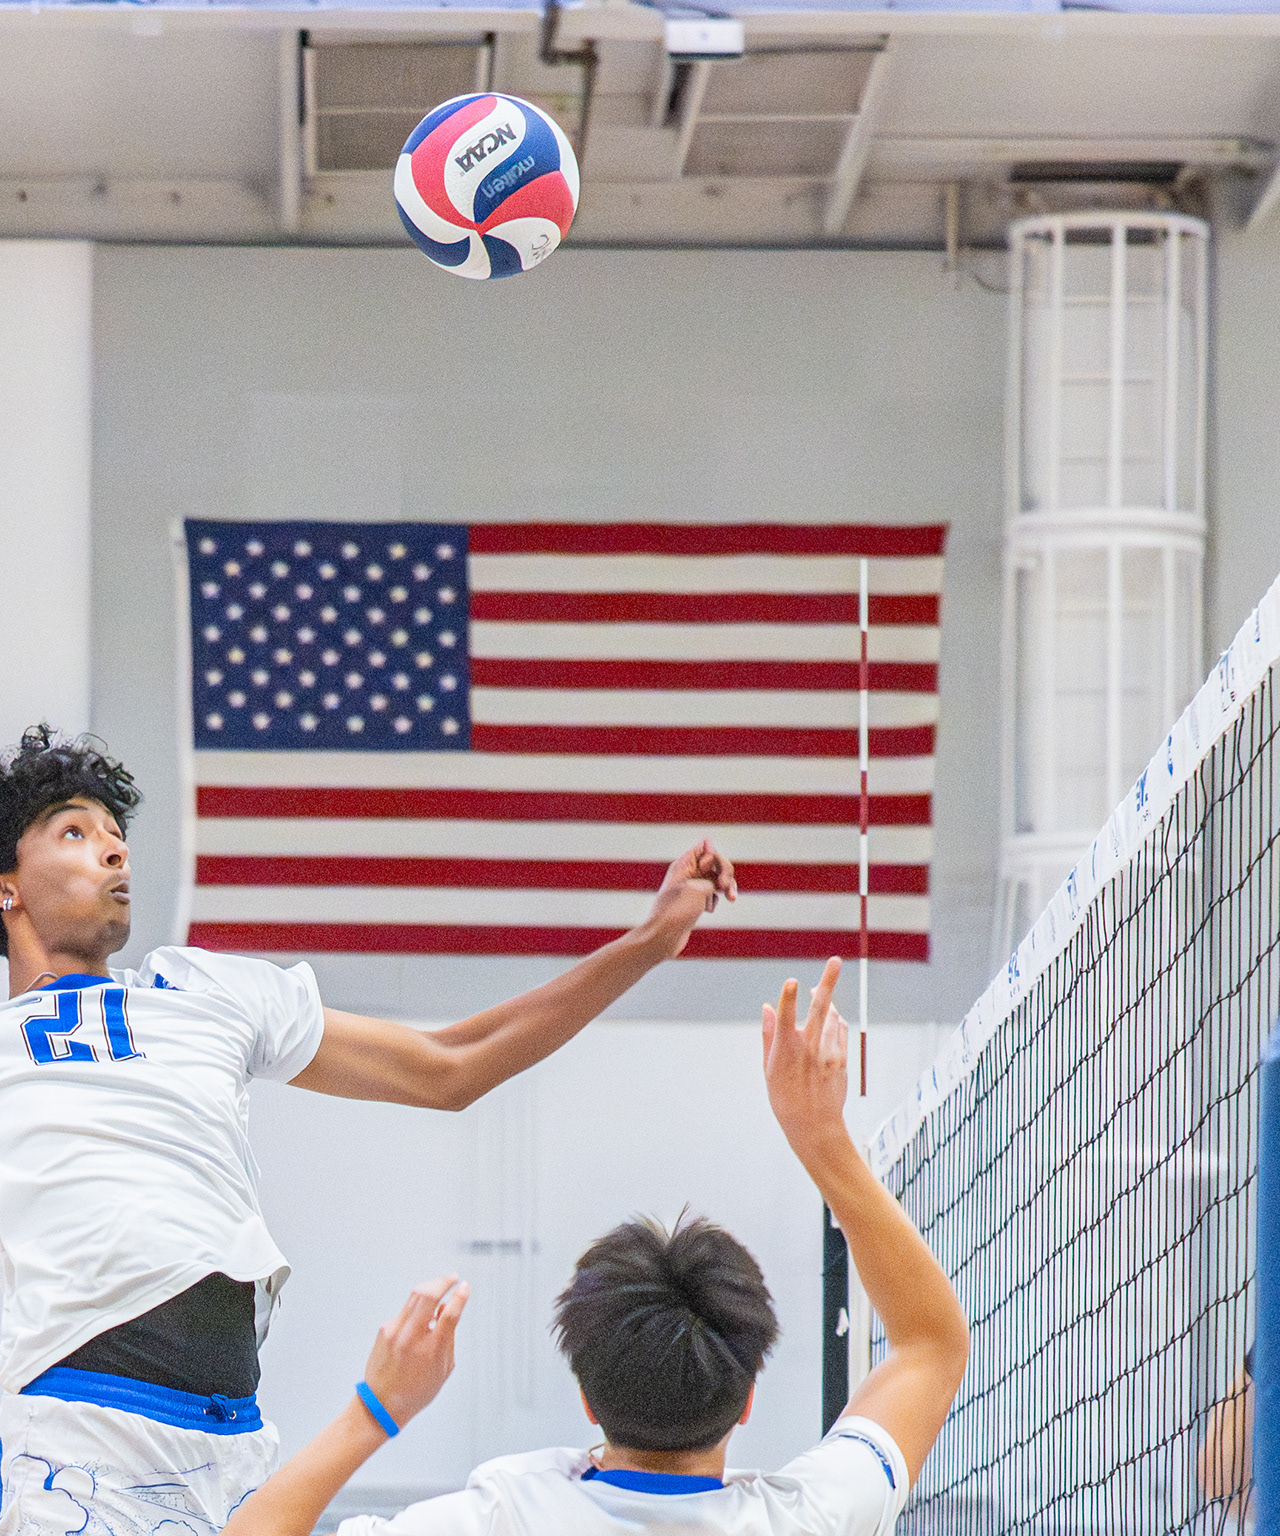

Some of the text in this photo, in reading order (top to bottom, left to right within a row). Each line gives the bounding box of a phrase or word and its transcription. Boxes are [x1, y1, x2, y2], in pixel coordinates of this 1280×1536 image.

[454, 122, 518, 174] NCAA
[479, 154, 536, 199] molten
[19, 987, 147, 1067] 21
